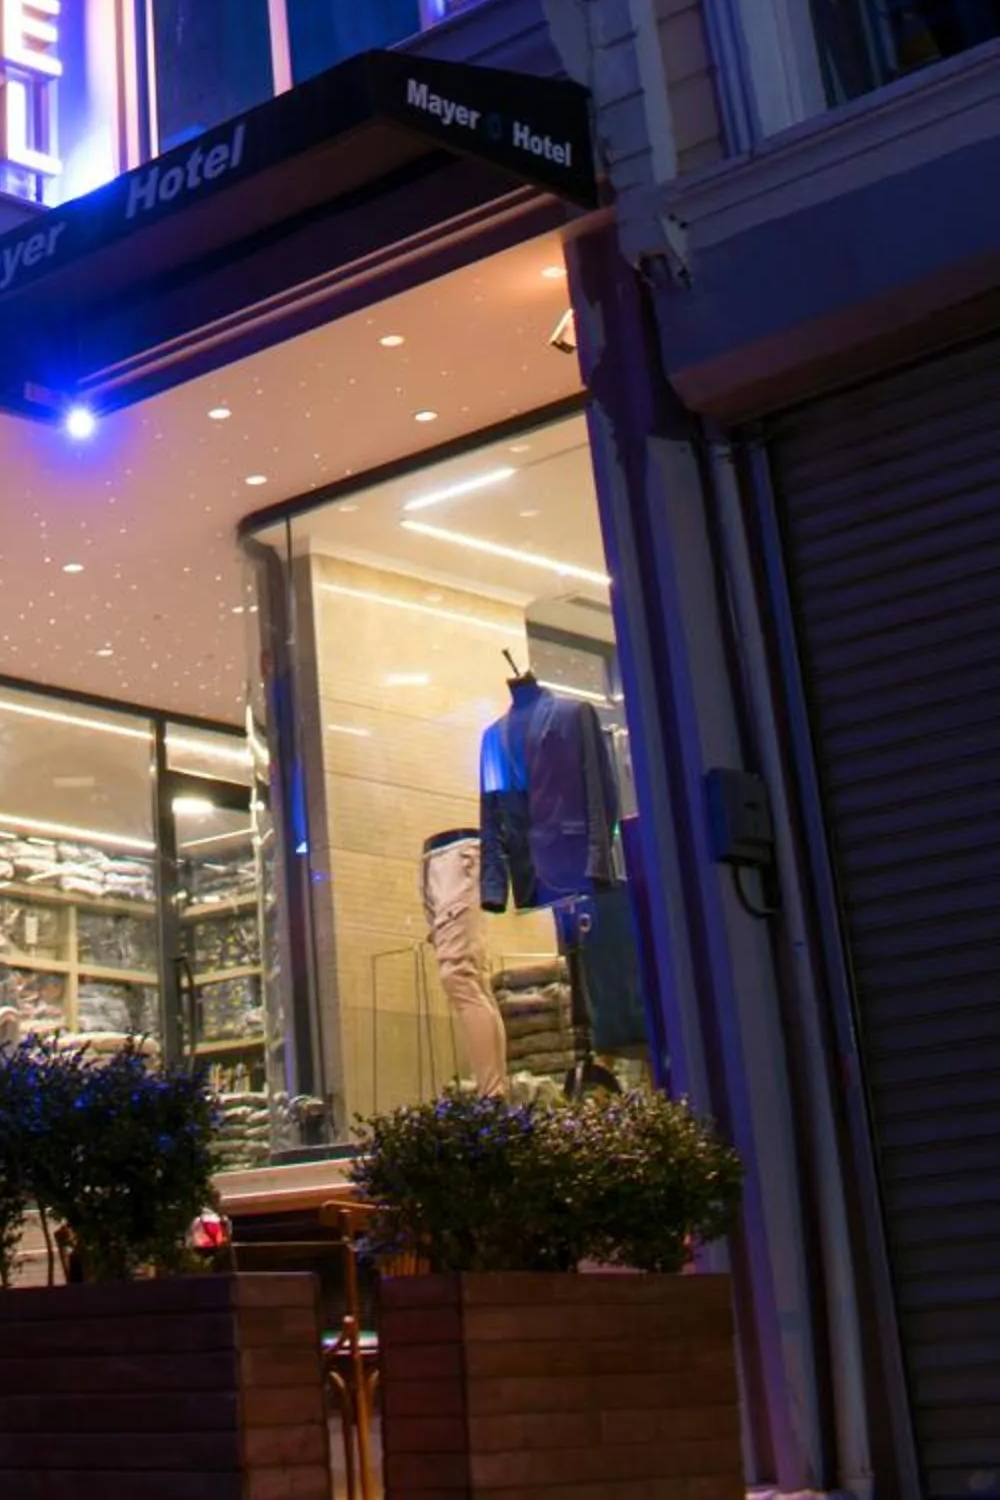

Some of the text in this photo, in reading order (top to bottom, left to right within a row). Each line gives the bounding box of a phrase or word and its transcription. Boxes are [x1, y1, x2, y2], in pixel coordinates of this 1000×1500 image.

[407, 78, 572, 167] Mayer Hotel
[125, 124, 247, 219] Hotel
